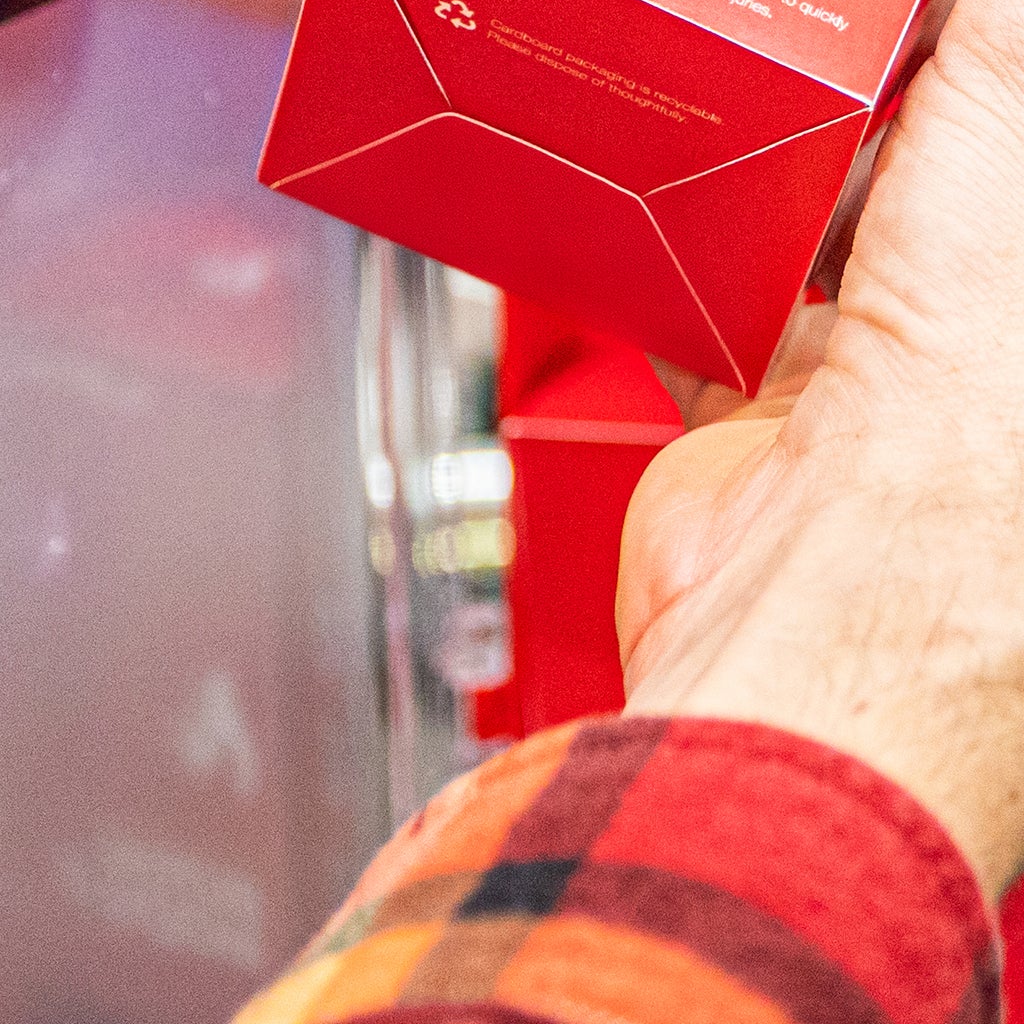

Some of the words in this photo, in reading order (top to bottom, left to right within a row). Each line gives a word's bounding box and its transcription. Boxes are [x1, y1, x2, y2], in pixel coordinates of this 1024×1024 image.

[799, 0, 849, 32] quickly
[486, 29, 533, 58] Please
[534, 52, 589, 82] dispose
[590, 77, 606, 88] of
[490, 18, 564, 57] Cardboard
[565, 52, 637, 92] packaging
[638, 84, 652, 96] is
